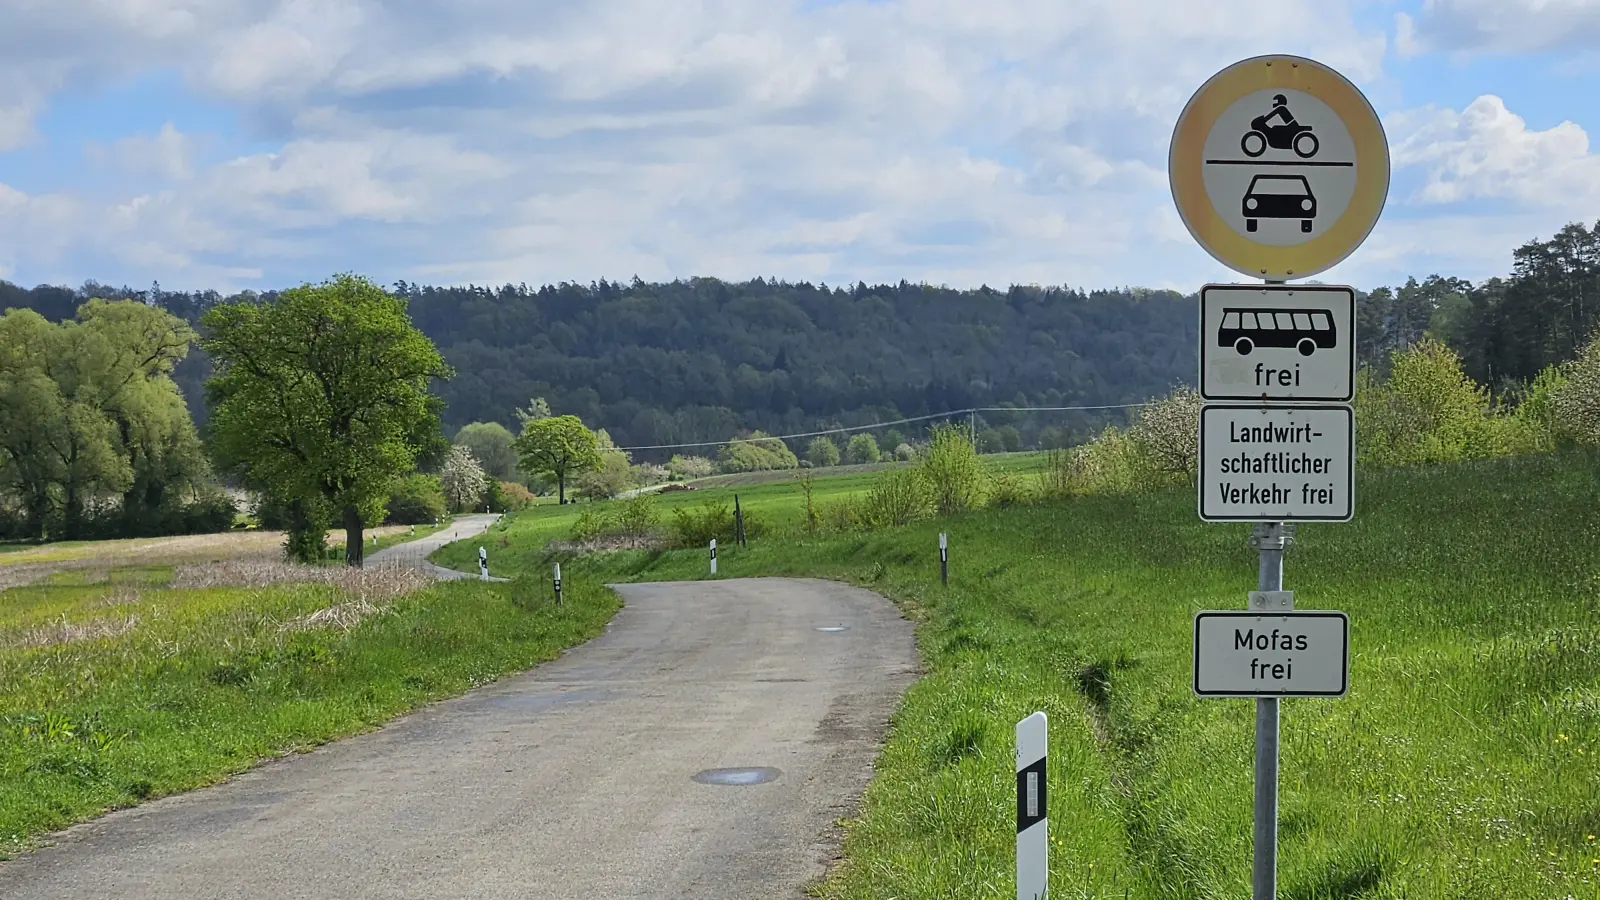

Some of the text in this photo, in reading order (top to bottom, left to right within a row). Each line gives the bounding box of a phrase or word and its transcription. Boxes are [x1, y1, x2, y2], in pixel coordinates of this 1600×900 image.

[1255, 363, 1300, 386] frei
[1230, 421, 1322, 443] Landwirt-
[1220, 452, 1332, 474] schaftlicher
[1220, 482, 1333, 504] Verkehr frei
[1234, 629, 1308, 650] Mofas
[1250, 658, 1292, 679] frei
